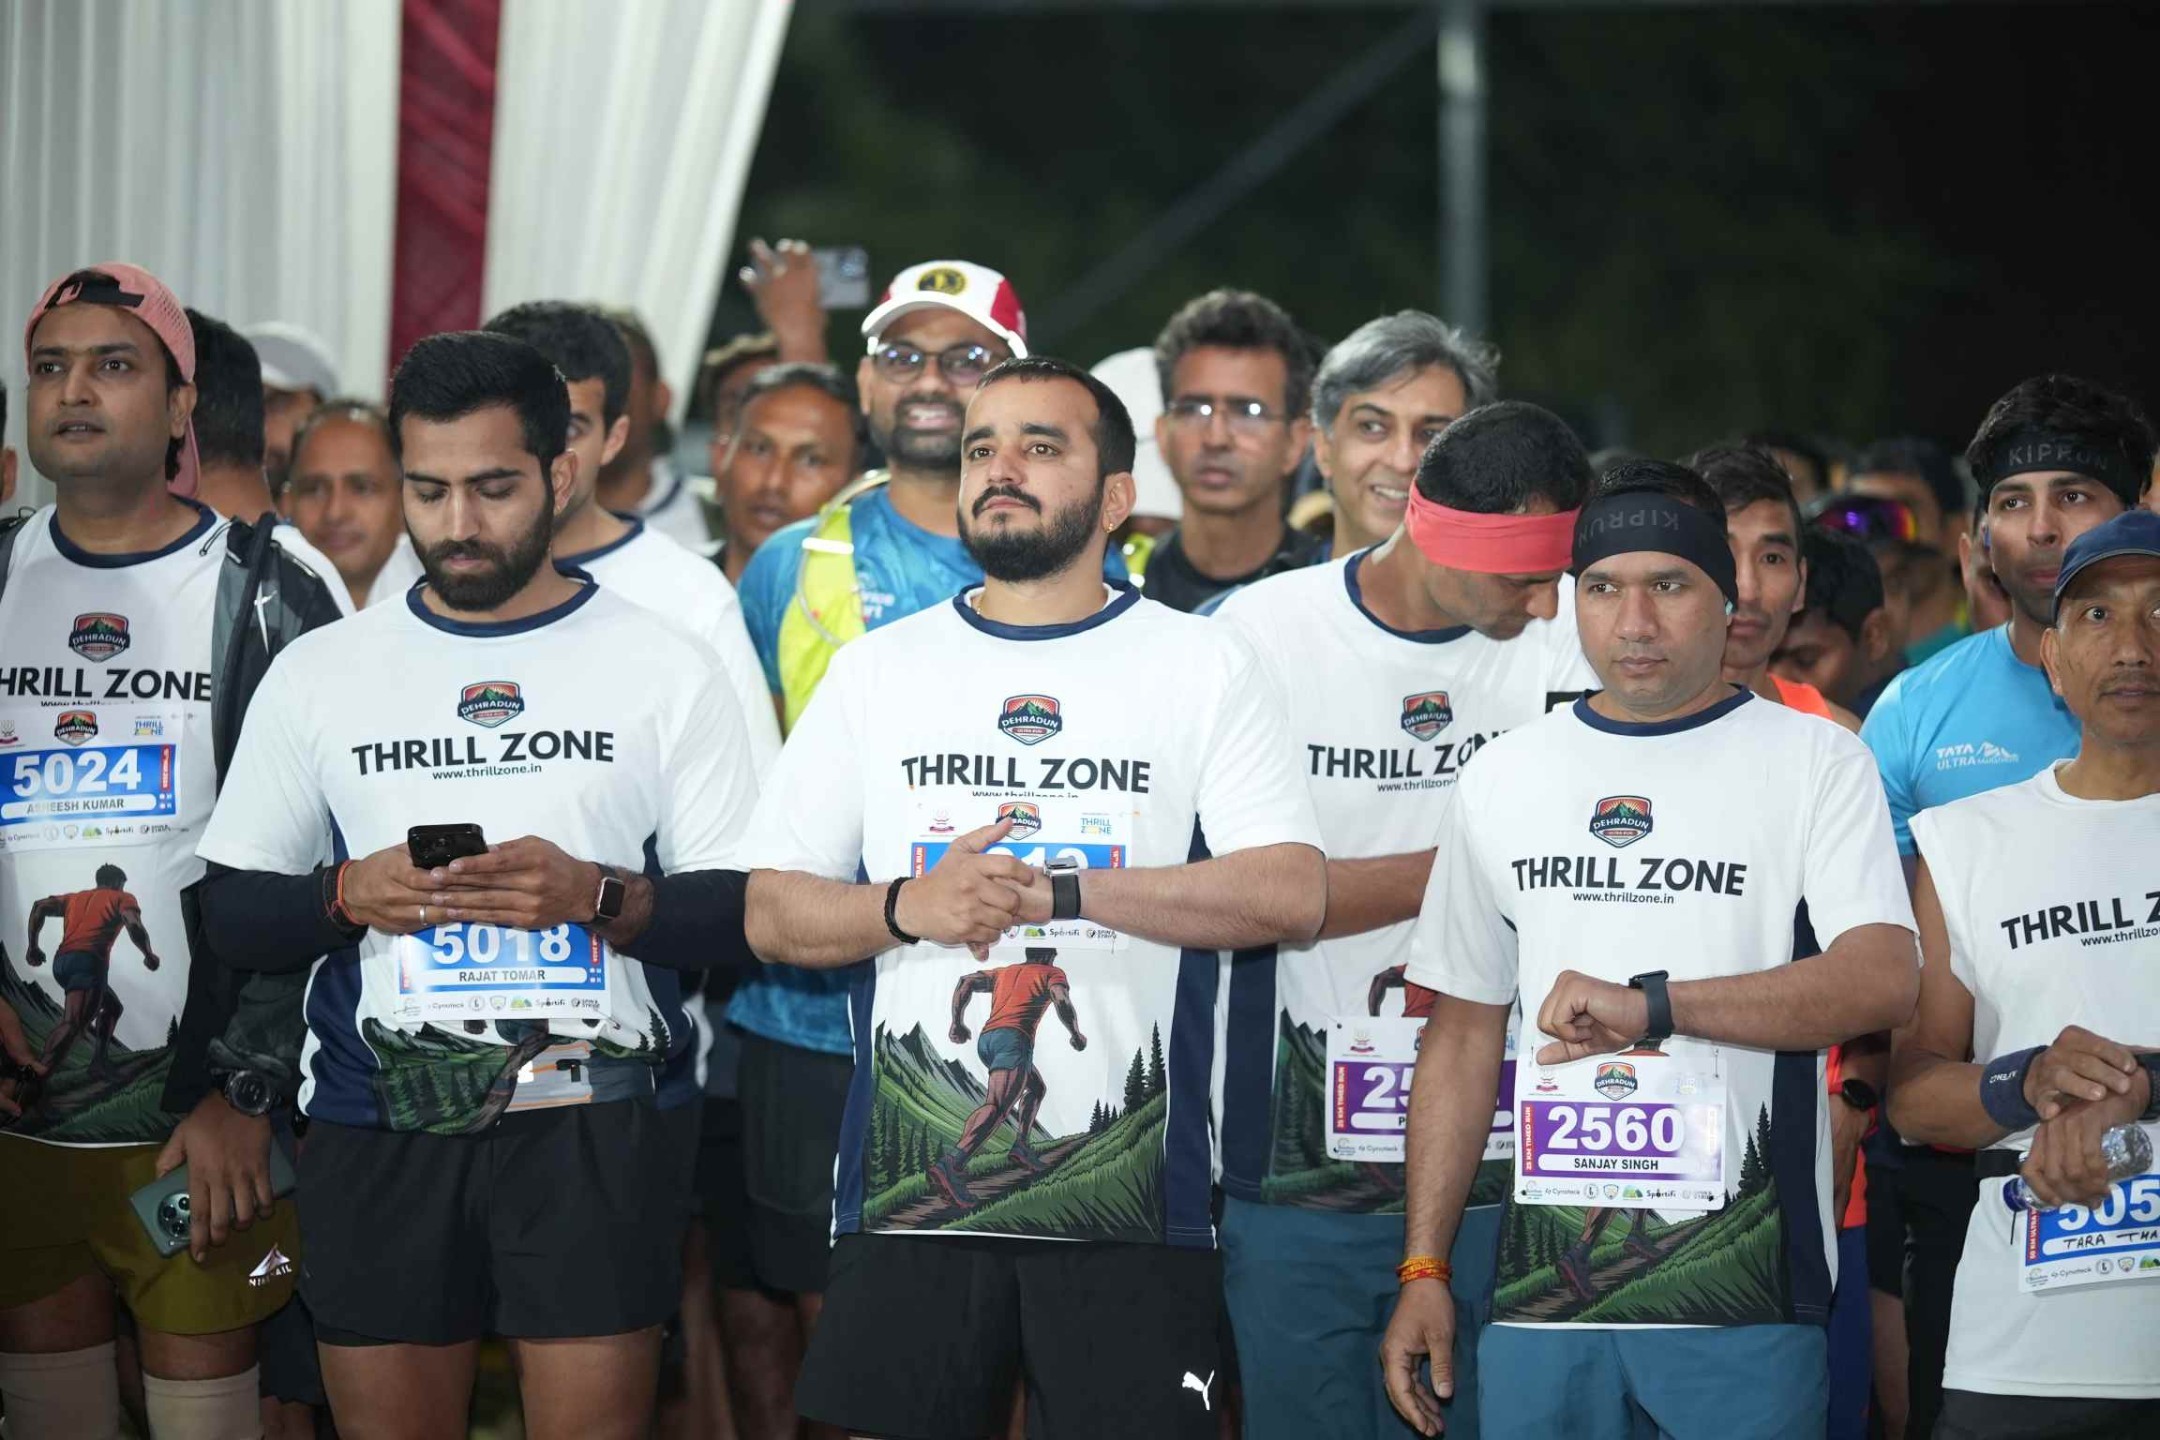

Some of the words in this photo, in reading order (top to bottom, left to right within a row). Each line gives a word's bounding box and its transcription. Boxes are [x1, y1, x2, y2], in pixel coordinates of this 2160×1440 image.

[2009, 443, 2109, 471] KIPRUN
[1577, 509, 1679, 548] KIPRUN
[72, 632, 126, 646] DEHRADUN
[0, 666, 92, 698] HRILL
[104, 669, 212, 701] ZONE
[461, 700, 520, 714] DEHRADUN
[1002, 715, 1059, 728] DEHRADUN
[351, 736, 487, 776] THRILL
[499, 730, 614, 763] ZONE
[1307, 744, 1423, 779] THRILL
[1433, 729, 1510, 776] ZO
[1936, 743, 1975, 758] TATA
[432, 763, 543, 780] www.thrillzone.in
[1937, 756, 1976, 771] ULTRA
[13, 748, 142, 797] 5024
[901, 754, 1026, 788] THRILL
[1038, 758, 1151, 793] ZONE
[83, 798, 125, 812] KUMAR
[1593, 817, 1649, 829] DEHRADUN
[1511, 856, 1625, 891] THRILL
[1636, 858, 1747, 896] ZONE
[1572, 891, 1675, 904] www.thrillzone.in
[2001, 897, 2134, 950] THRILL
[431, 923, 572, 964] 5018
[458, 970, 498, 983] RAJAT
[503, 969, 546, 982] TOMAR
[1596, 1078, 1636, 1088] DEHRADUN
[1547, 1105, 1686, 1152] 2560
[1574, 1157, 1619, 1170] SANJAY
[1622, 1158, 1659, 1171] SINGH
[2063, 1233, 2106, 1249] TARA
